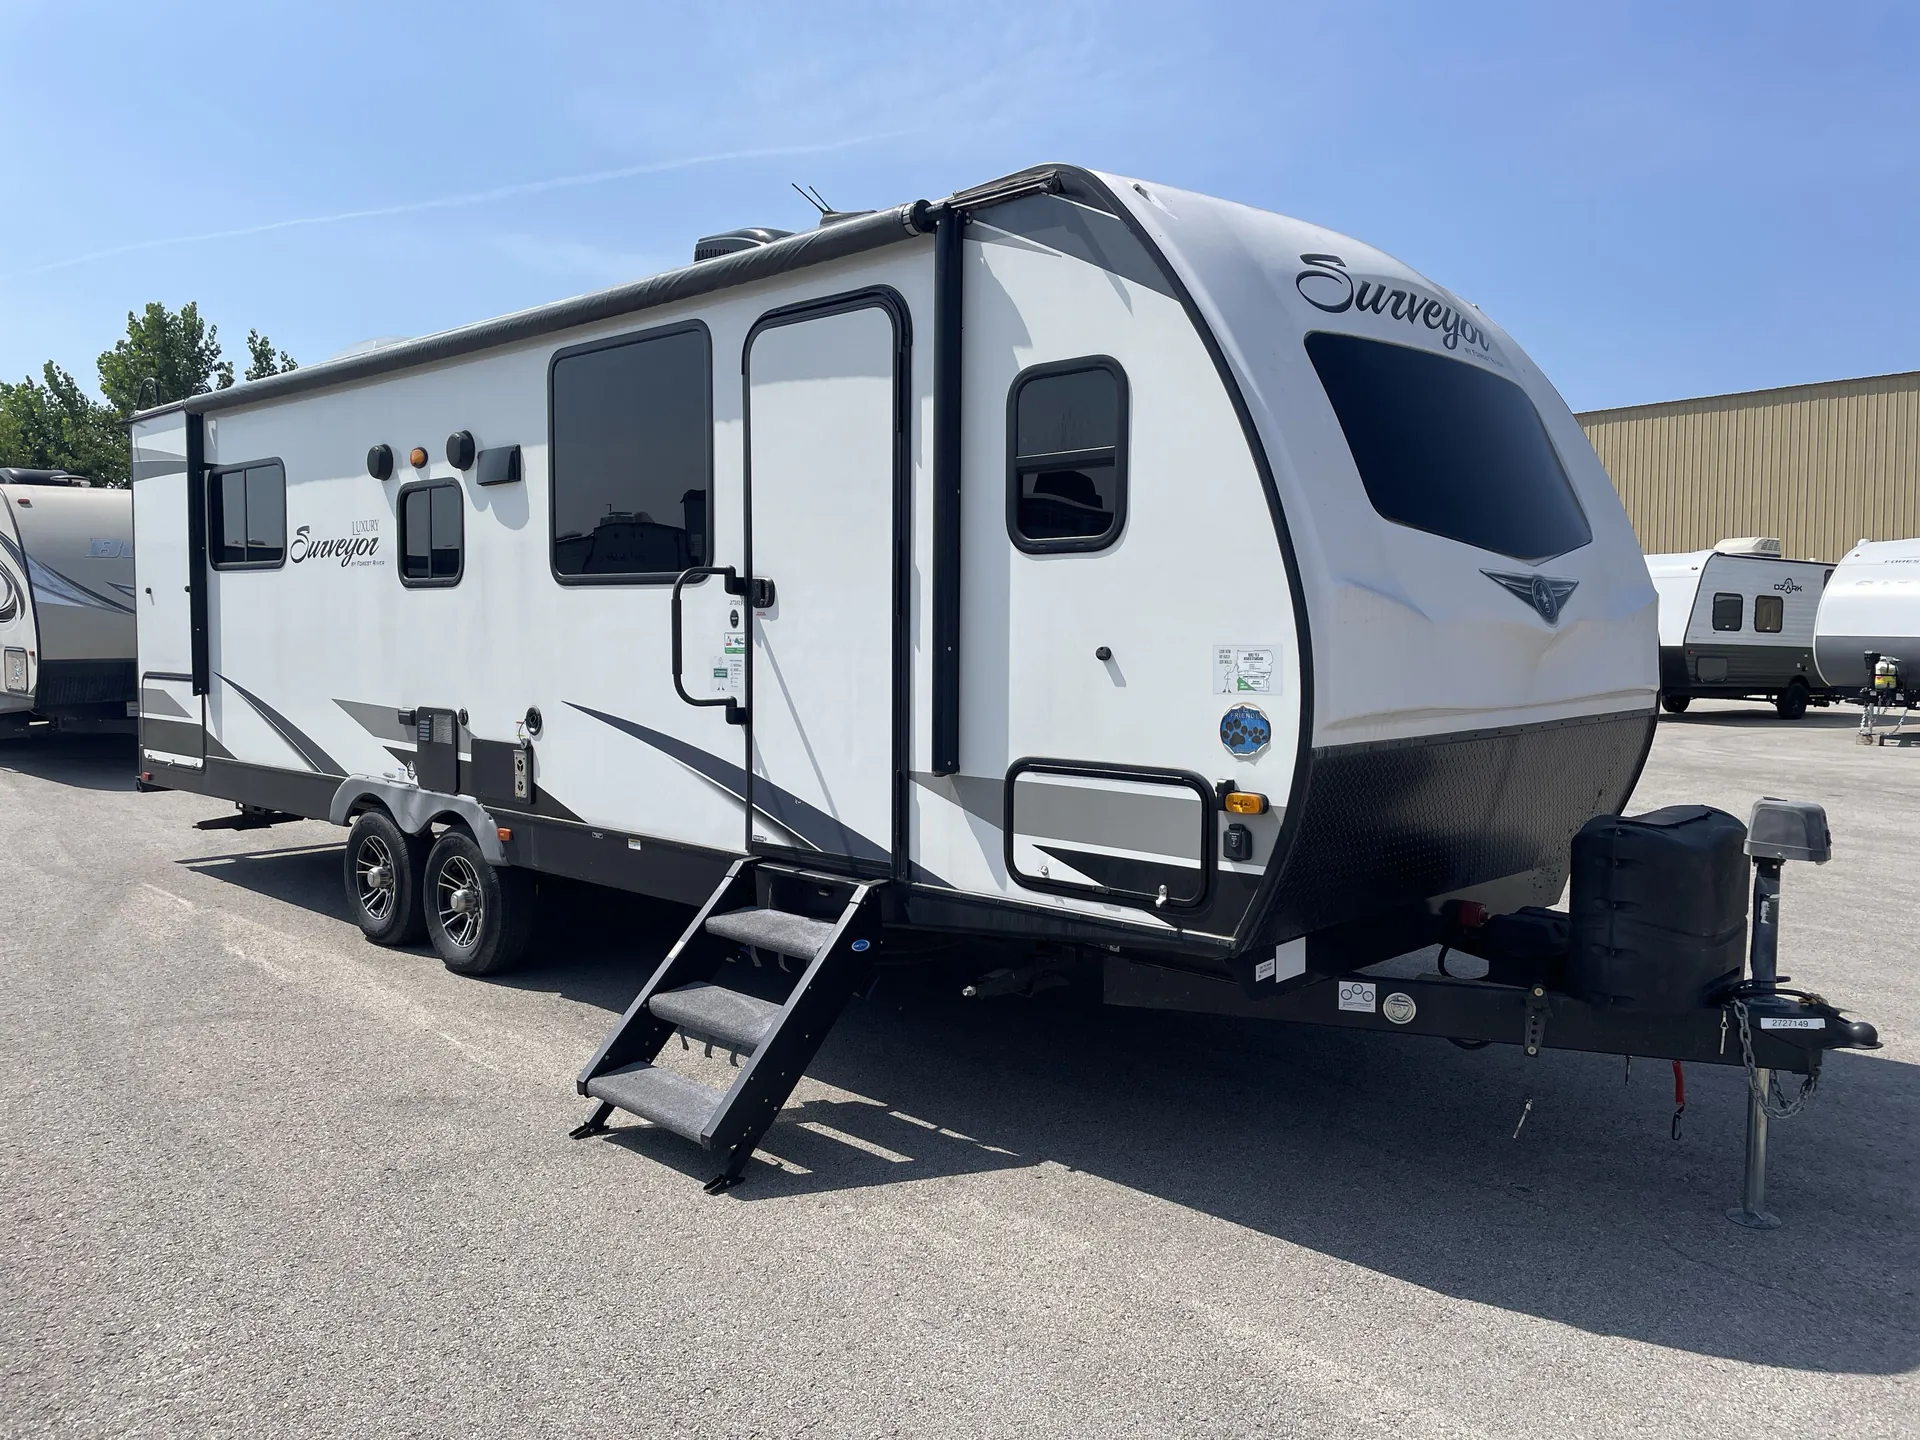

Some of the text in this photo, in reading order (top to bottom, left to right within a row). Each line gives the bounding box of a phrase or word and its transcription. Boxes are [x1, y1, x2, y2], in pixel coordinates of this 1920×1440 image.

[1295, 253, 1490, 351] Surveyor
[352, 520, 379, 535] LUXURY
[290, 525, 379, 567] Surveyor
[1773, 581, 1803, 593] OZARK
[1772, 1019, 1809, 1028] 2727149
